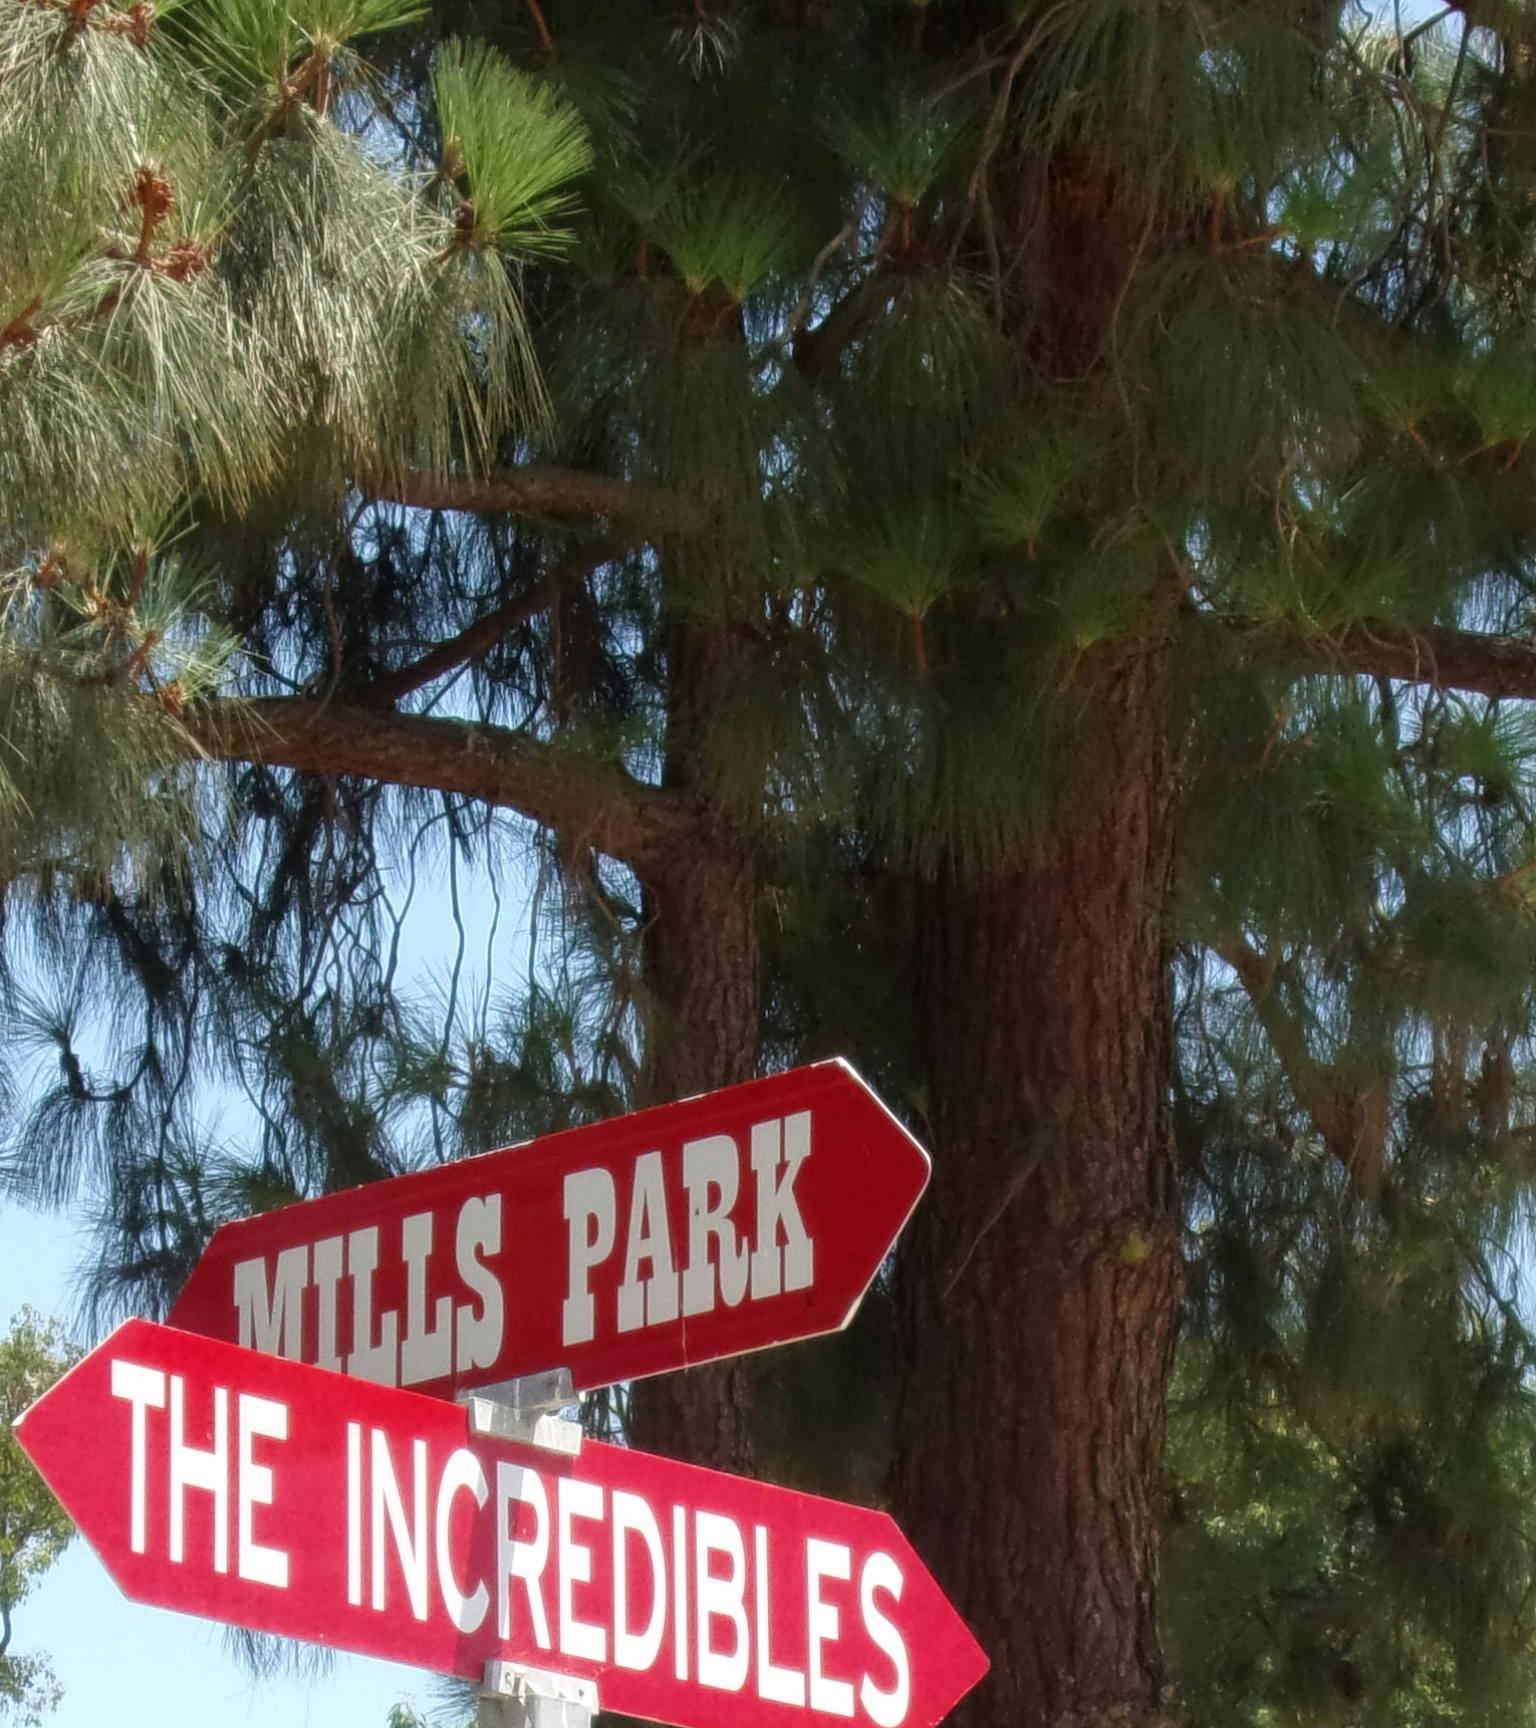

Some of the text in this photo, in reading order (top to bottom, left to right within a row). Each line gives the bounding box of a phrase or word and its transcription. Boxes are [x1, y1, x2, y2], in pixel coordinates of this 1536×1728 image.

[233, 1110, 814, 1388] MILLS PARK
[110, 1359, 290, 1589] THE
